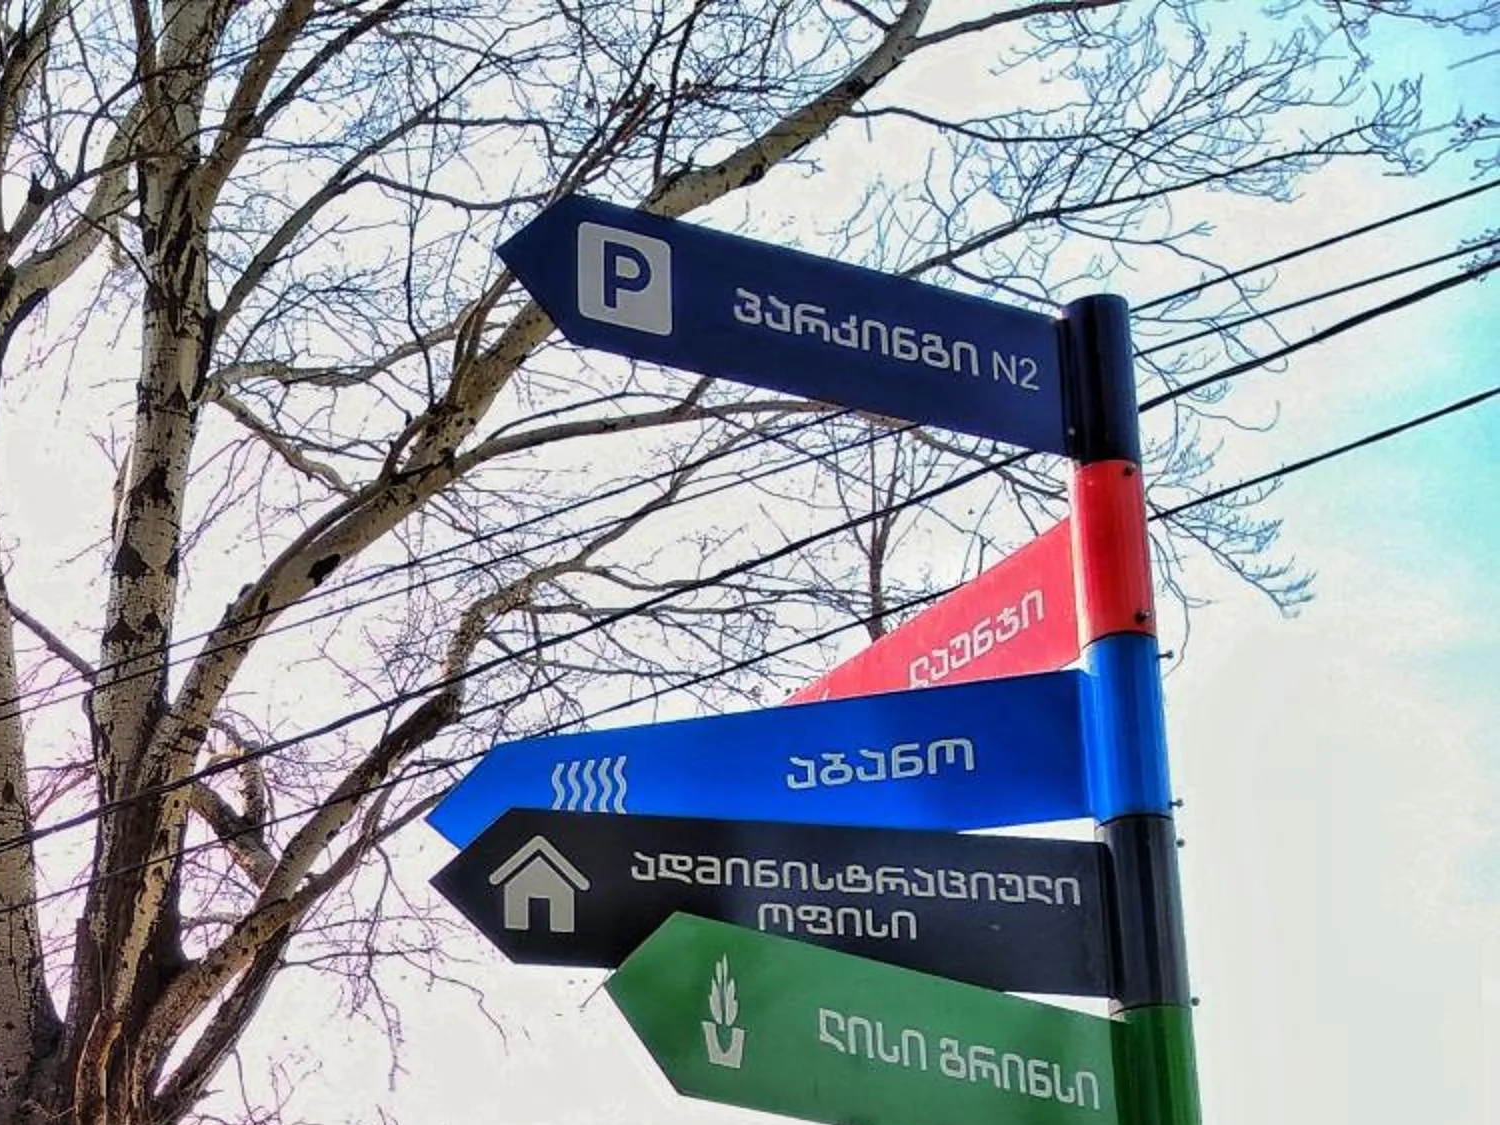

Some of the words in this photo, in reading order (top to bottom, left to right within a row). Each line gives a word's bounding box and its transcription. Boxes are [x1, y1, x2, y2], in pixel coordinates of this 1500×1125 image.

[604, 241, 651, 309] P
[733, 287, 979, 376] პარკინგი
[991, 350, 1040, 391] N2
[787, 737, 975, 790] აბანო
[631, 851, 1082, 906] ადმინისტრაციული
[757, 902, 917, 940] ოფისი
[819, 1008, 928, 1070] ლისი
[939, 1037, 1100, 1110] გრინსი
